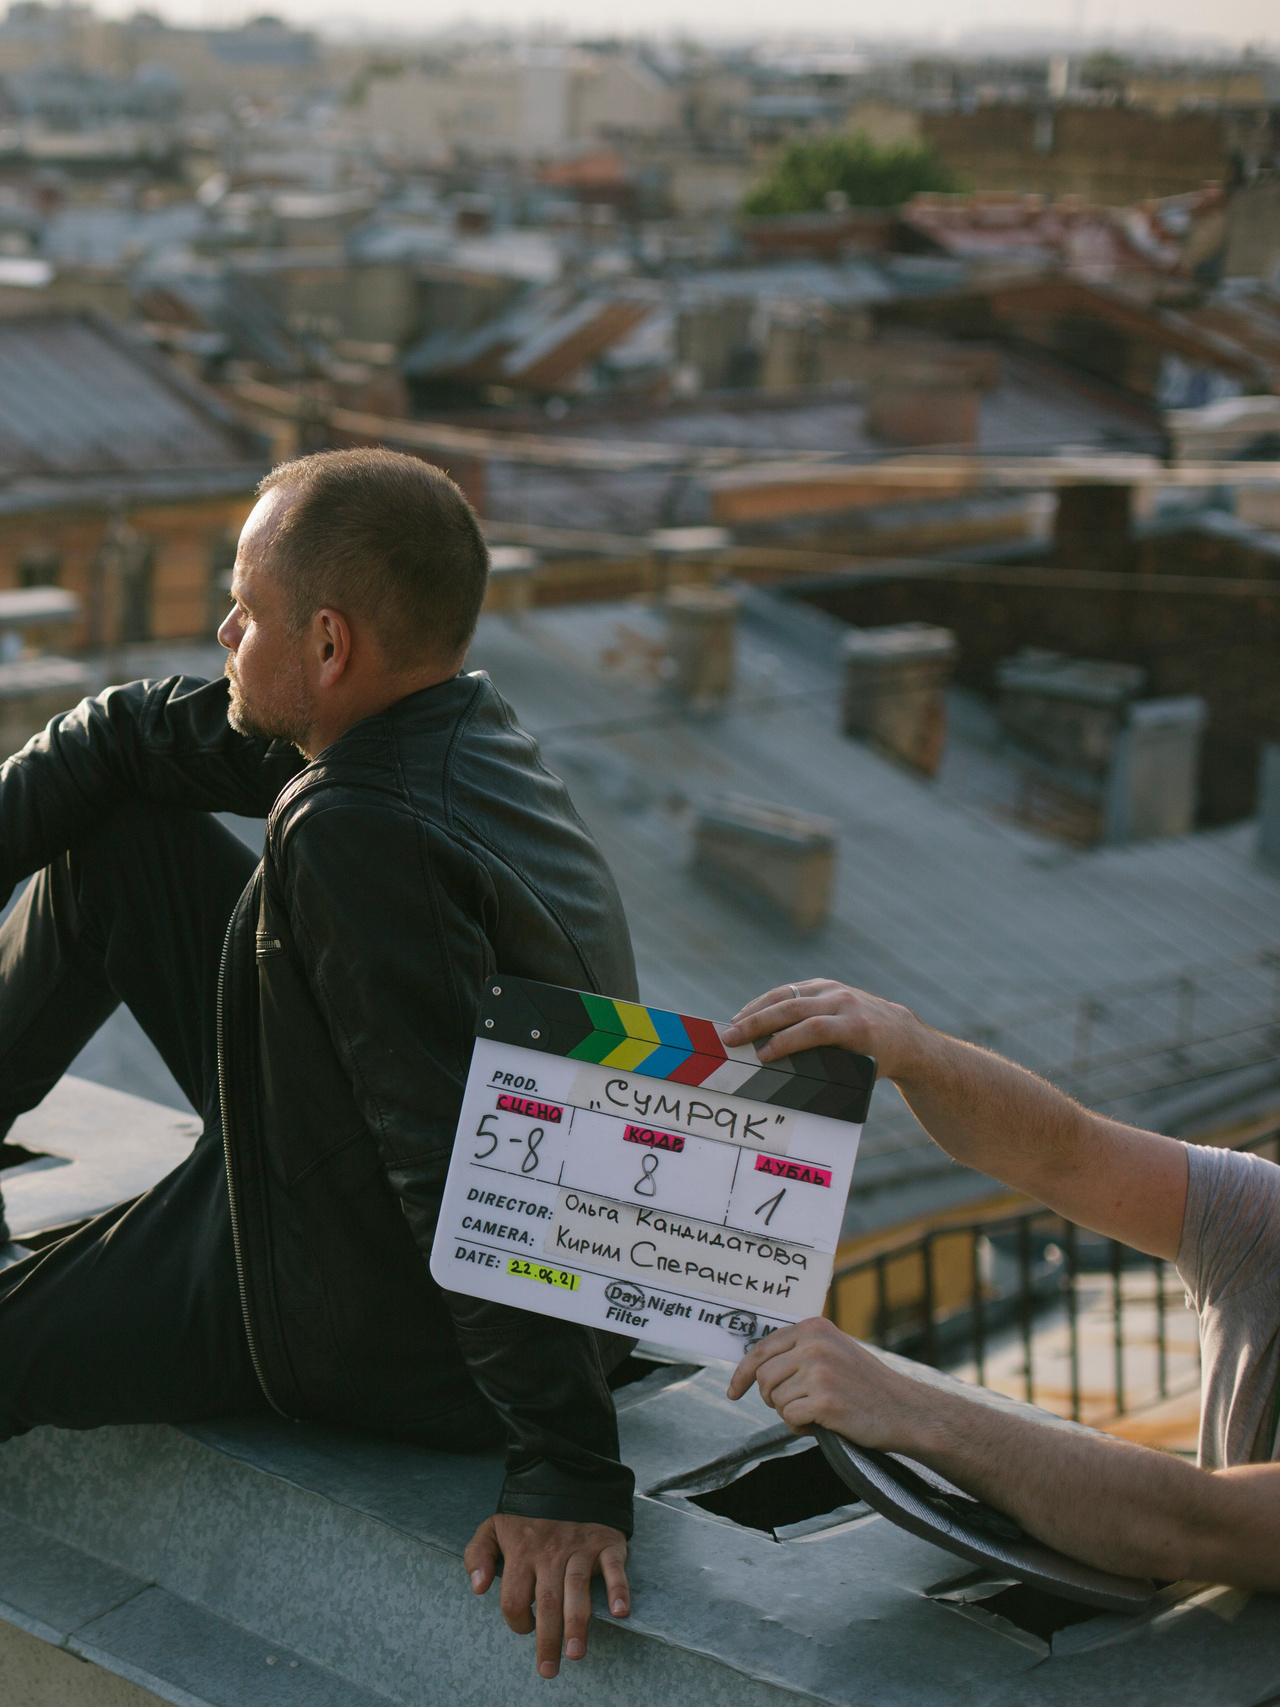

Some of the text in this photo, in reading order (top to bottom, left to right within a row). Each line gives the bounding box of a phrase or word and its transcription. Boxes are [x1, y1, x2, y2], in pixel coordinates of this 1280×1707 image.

[492, 1070, 538, 1092] PROD.
[474, 1114, 544, 1173] 5-8
[633, 1153, 659, 1197] 8
[466, 1188, 554, 1220] DIRECTOR:
[754, 1187, 787, 1226] 1
[461, 1215, 535, 1246] CAMERA:
[565, 1193, 807, 1270] Ольга Кандидатова
[454, 1246, 501, 1268] DATE:
[556, 1225, 800, 1298] Кирилл Сперанский
[510, 1260, 576, 1291] 22.06.21
[605, 1306, 650, 1329] Filter
[647, 1296, 692, 1318] Night
[698, 1308, 722, 1326] Int
[727, 1315, 757, 1335] Ext
